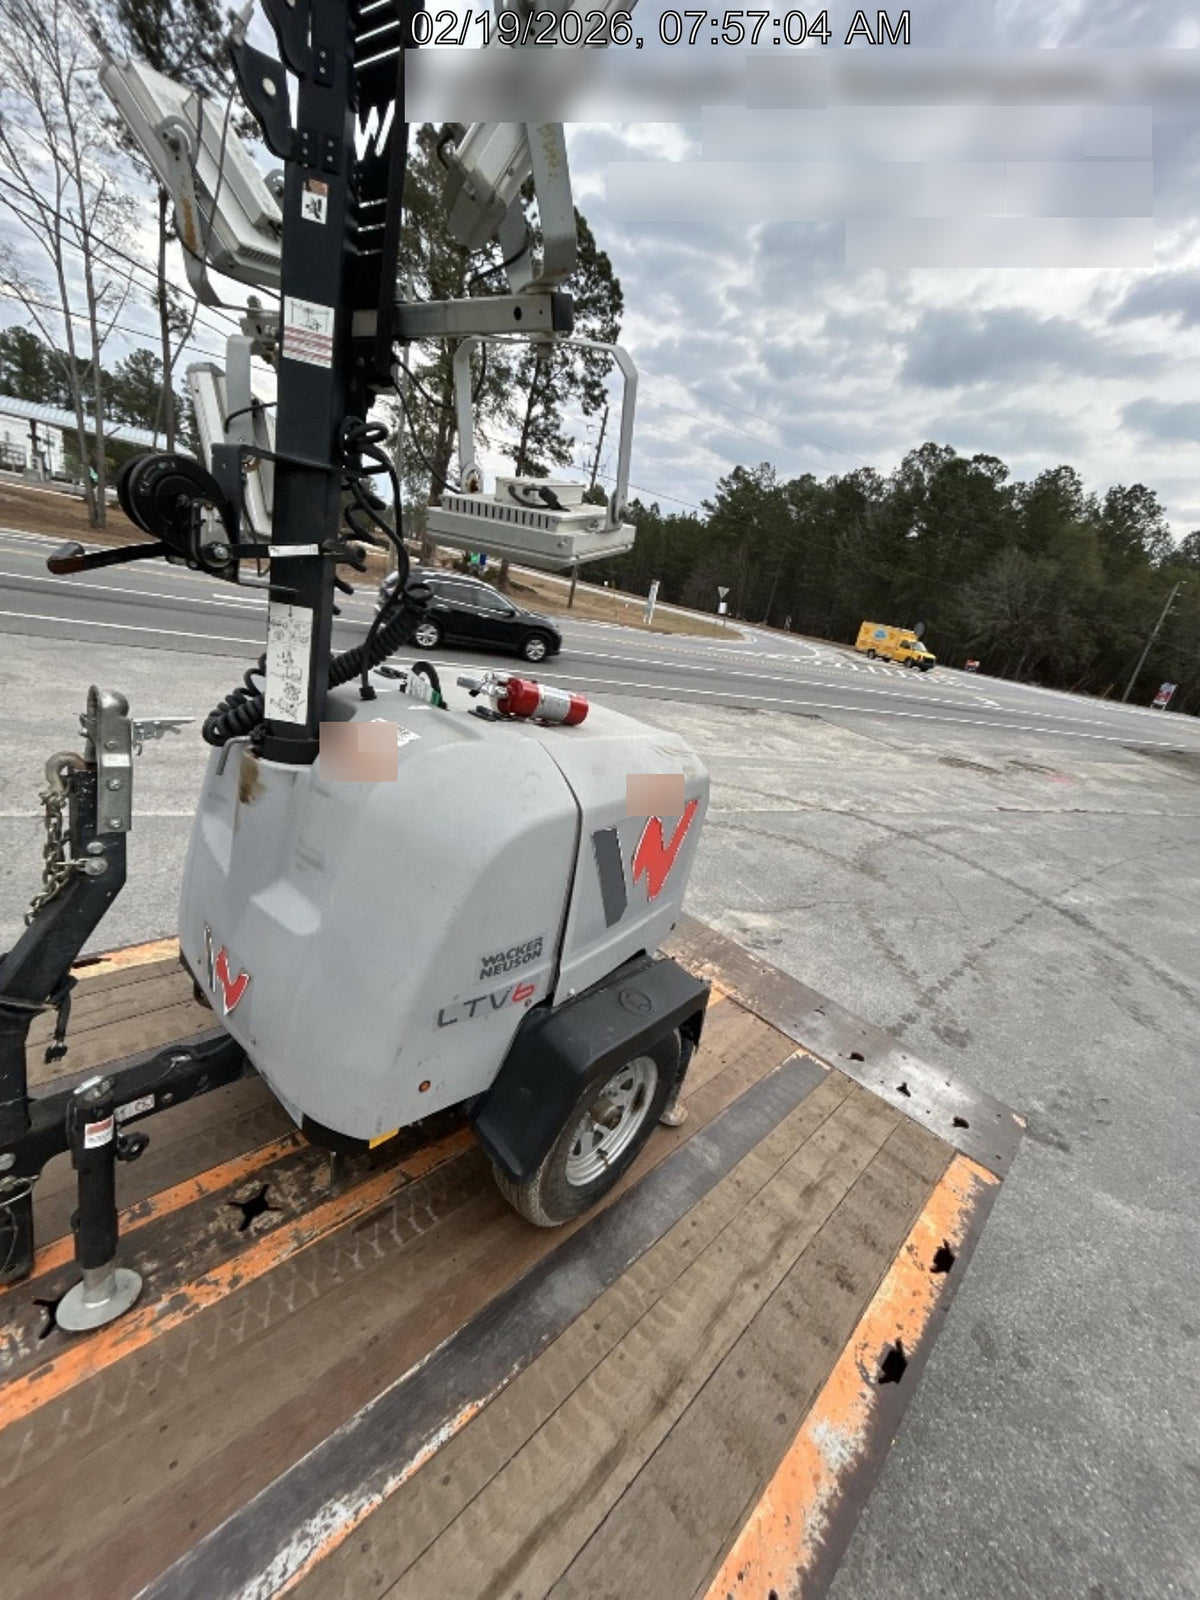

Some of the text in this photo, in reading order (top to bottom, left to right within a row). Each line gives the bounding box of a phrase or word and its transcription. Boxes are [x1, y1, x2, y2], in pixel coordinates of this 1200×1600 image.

[479, 947, 543, 980] NEUSON
[481, 936, 543, 968] WACKER
[437, 982, 536, 1028] LTV6
